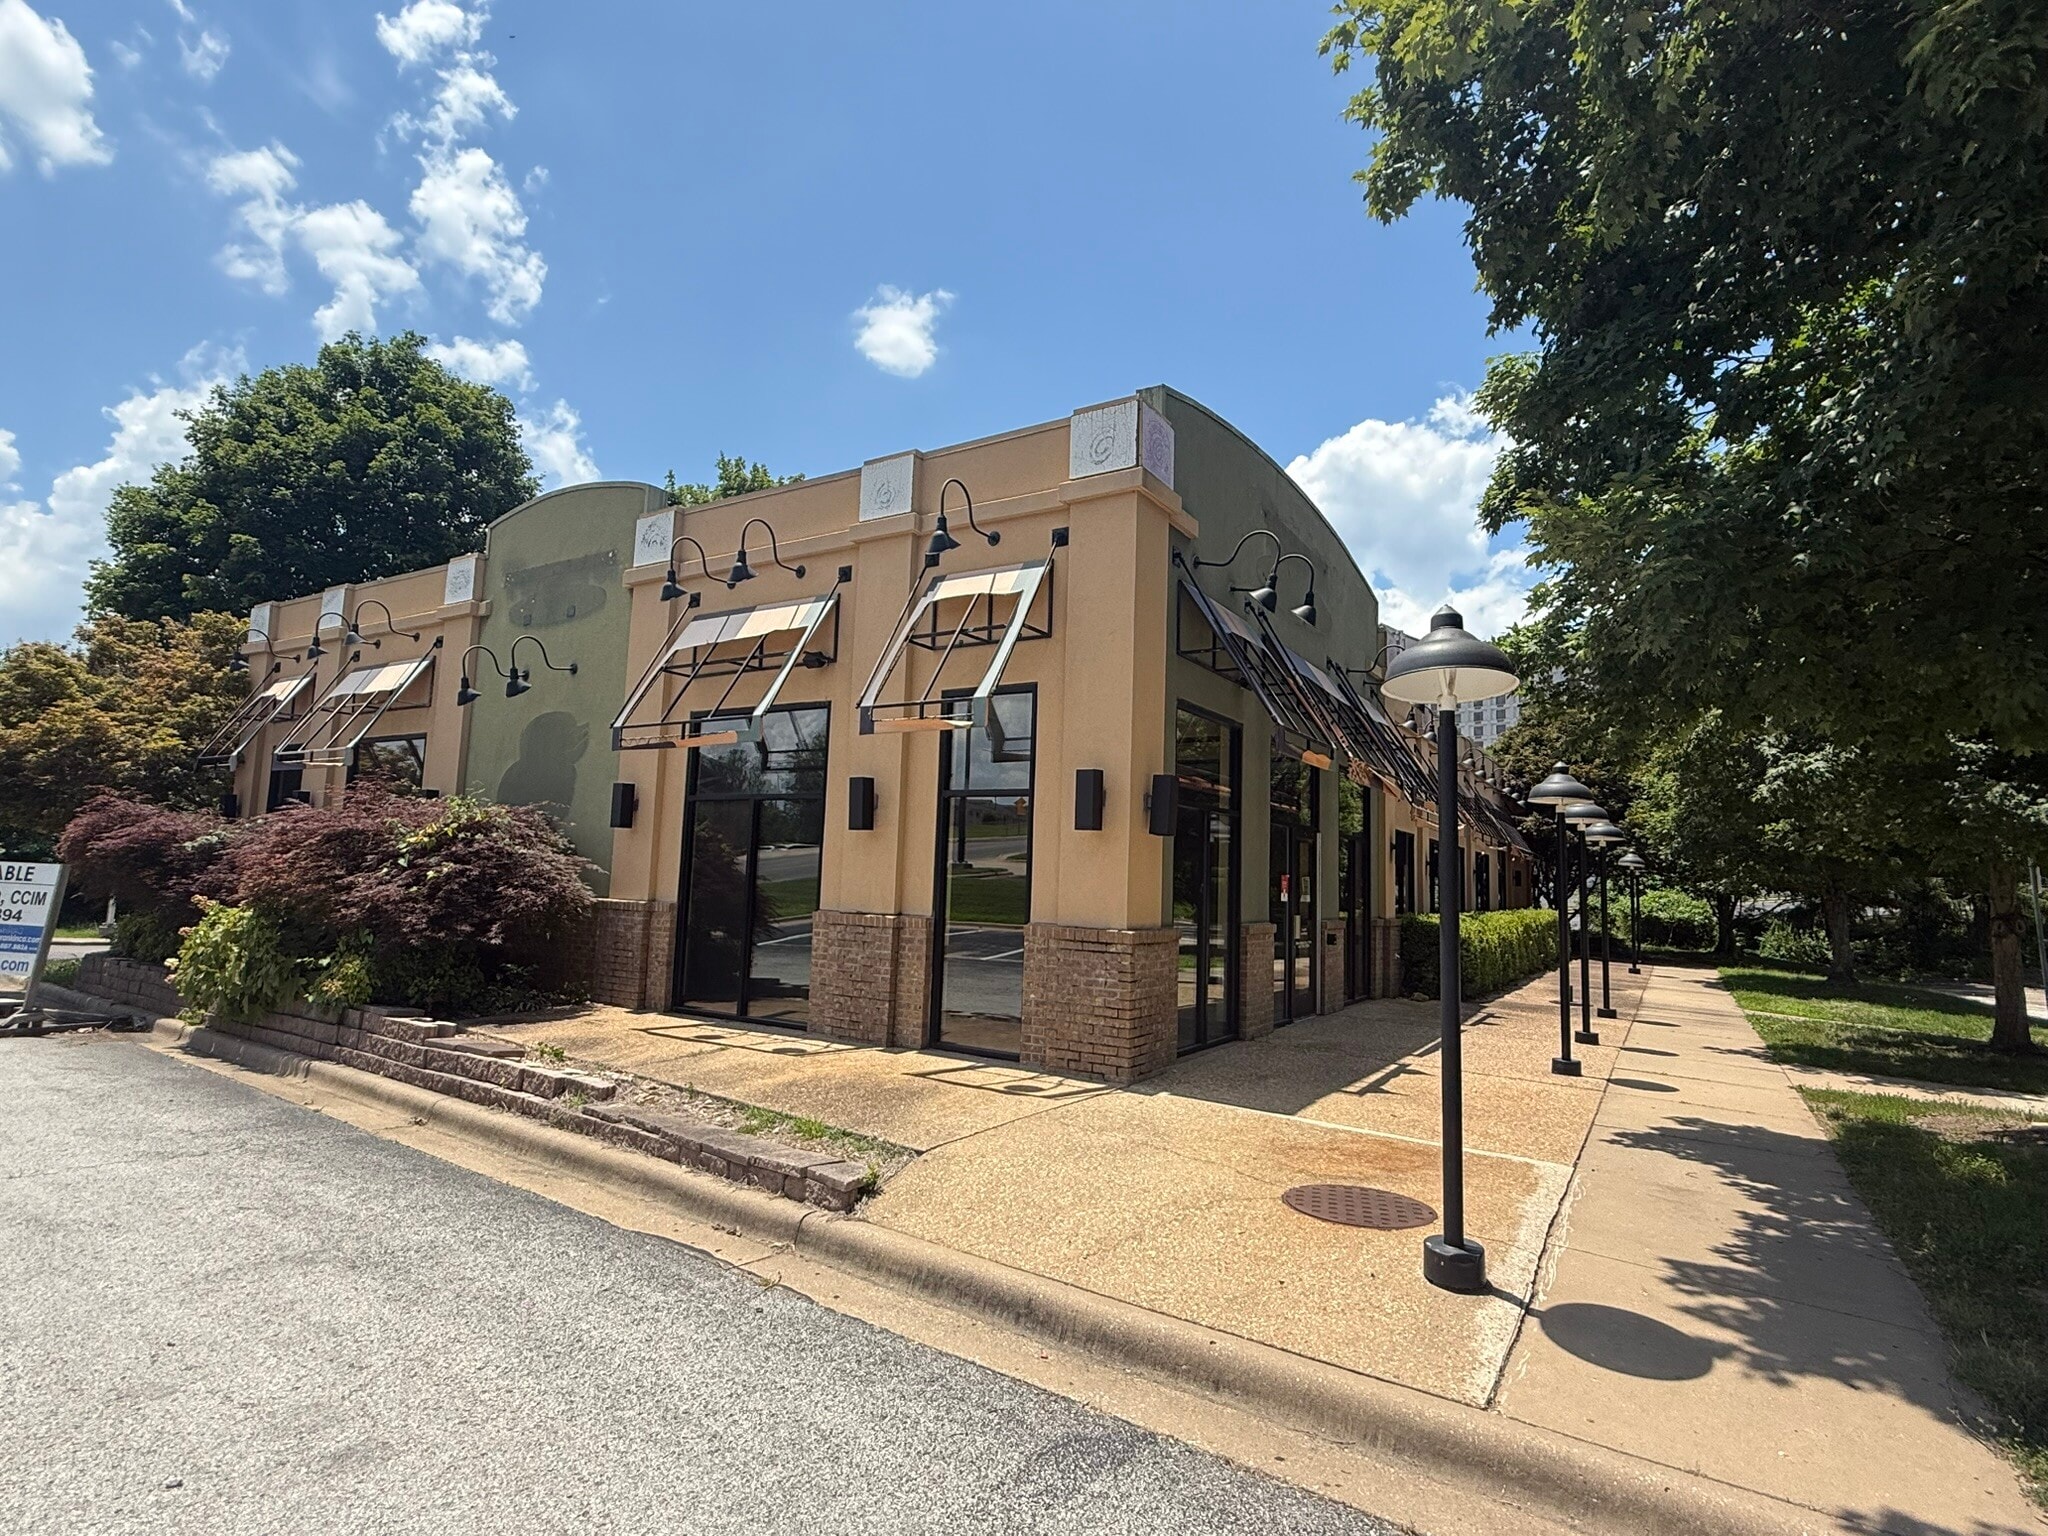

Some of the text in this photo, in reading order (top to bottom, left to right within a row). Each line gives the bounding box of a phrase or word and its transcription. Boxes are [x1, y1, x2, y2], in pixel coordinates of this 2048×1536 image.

[0, 865, 36, 881] BLE
[10, 890, 48, 906] CCIM
[0, 908, 23, 922] 94
